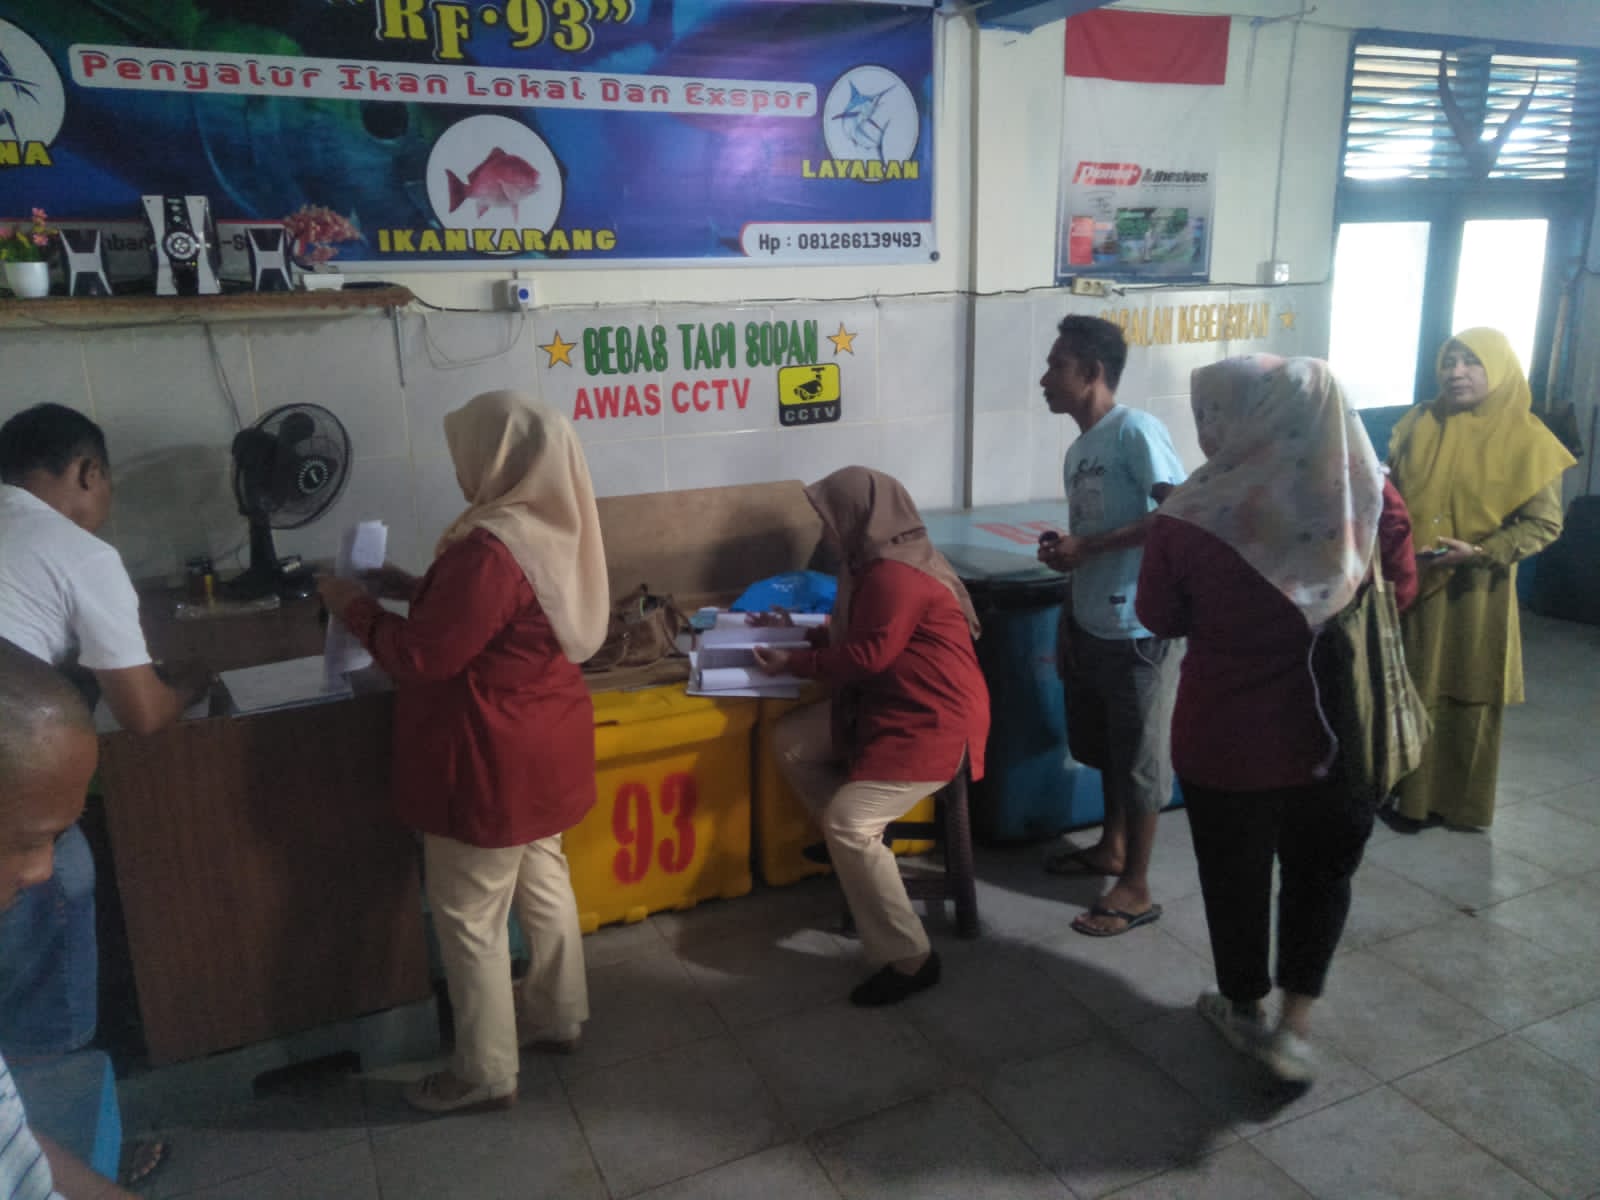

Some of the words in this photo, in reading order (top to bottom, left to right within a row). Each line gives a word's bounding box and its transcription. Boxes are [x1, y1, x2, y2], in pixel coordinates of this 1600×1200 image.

[80, 52, 320, 90] Penyalur
[337, 66, 448, 95] Ikan
[465, 72, 585, 100] Lokal
[600, 79, 669, 105] Dan
[685, 84, 811, 112] Exspor
[802, 160, 919, 180] LAYARAN
[759, 234, 780, 255] Hp
[798, 232, 921, 249] 081266139493
[582, 324, 668, 376] BEBAS
[677, 321, 736, 370] TAPI
[745, 320, 818, 367] SOPAN
[573, 383, 661, 420] AWAS
[671, 378, 751, 413] CCTV
[784, 405, 836, 422] CCTV
[611, 771, 697, 884] 93
